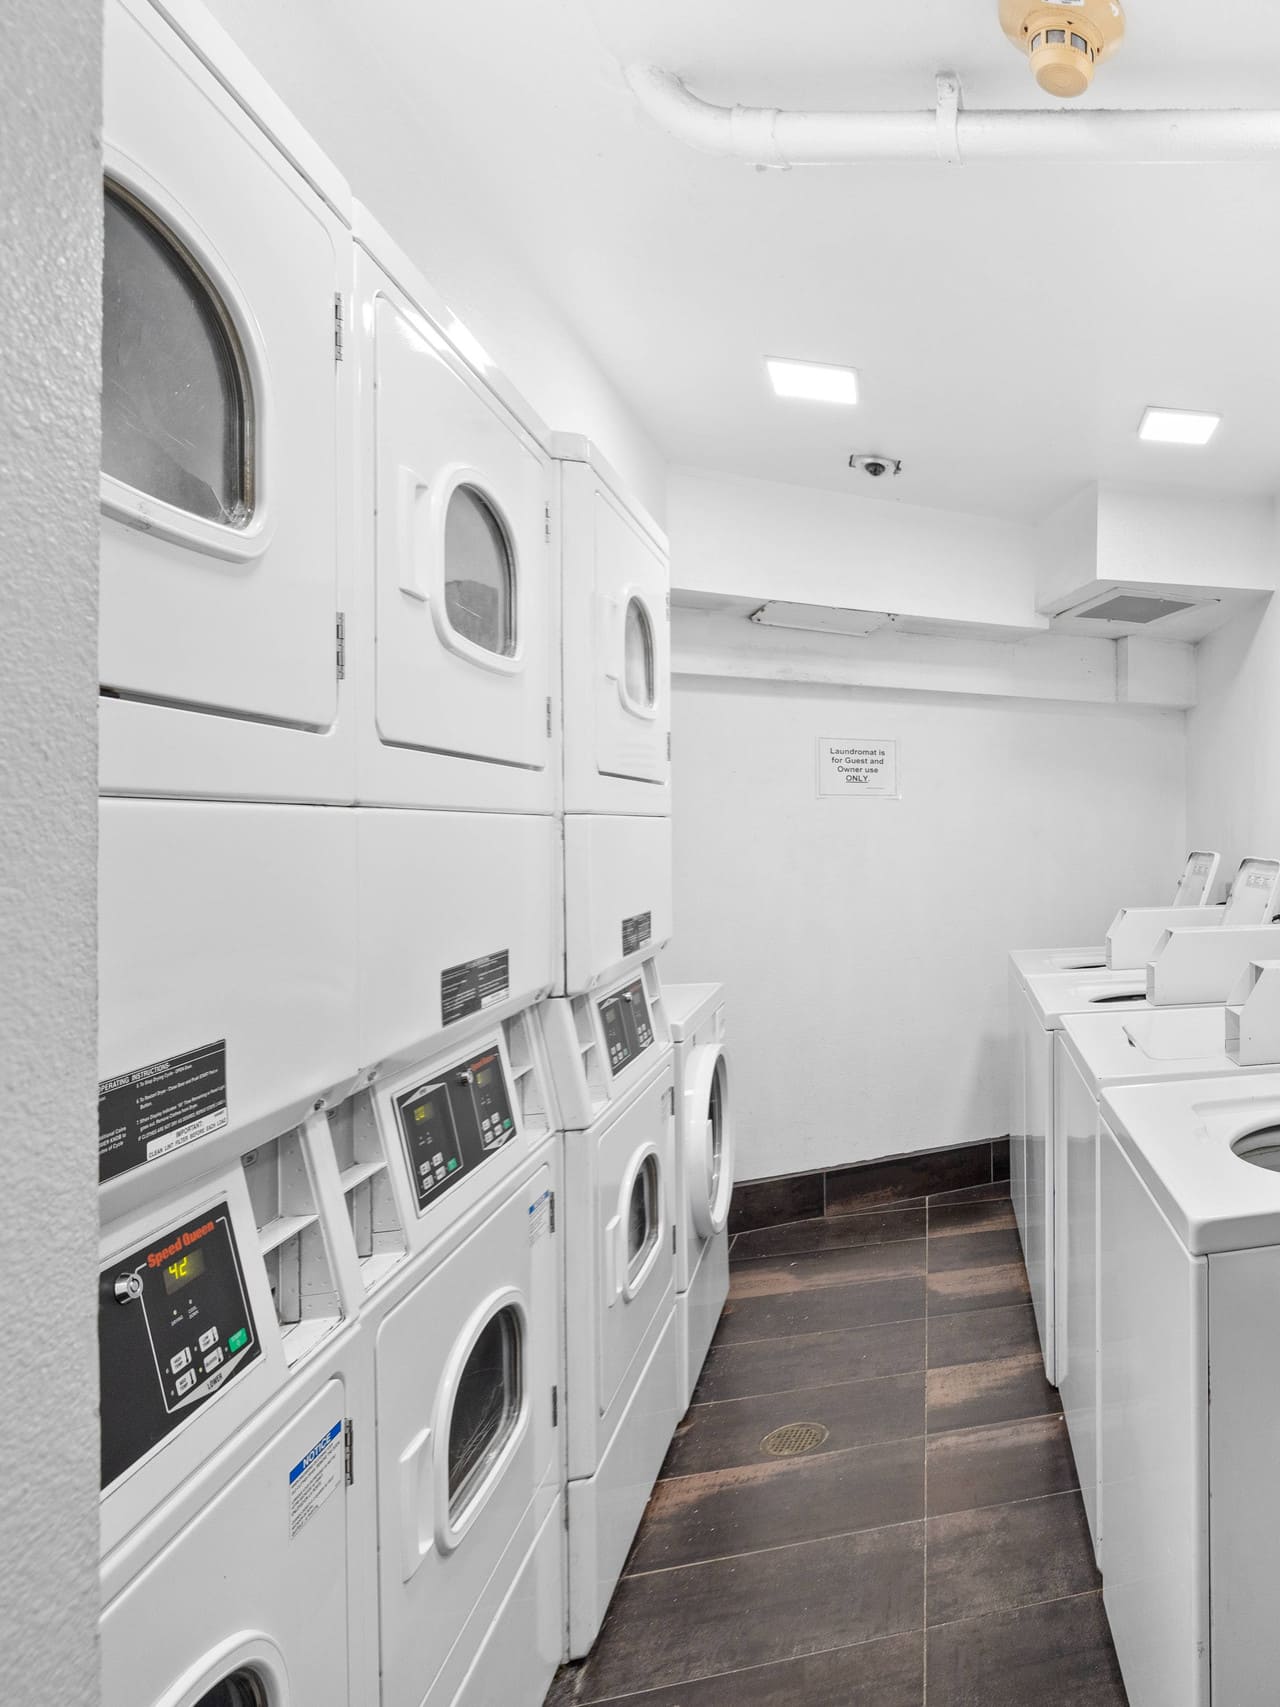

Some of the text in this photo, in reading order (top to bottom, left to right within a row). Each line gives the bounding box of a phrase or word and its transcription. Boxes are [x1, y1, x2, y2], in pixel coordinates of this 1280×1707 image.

[830, 748, 877, 756] Laundromat
[837, 765, 863, 773] Owner
[845, 757, 868, 765] Guest
[147, 1220, 216, 1269] Speed Queen
[168, 1256, 188, 1280] 42
[207, 1373, 223, 1390] LOWER
[302, 1432, 332, 1469] NOTICE
